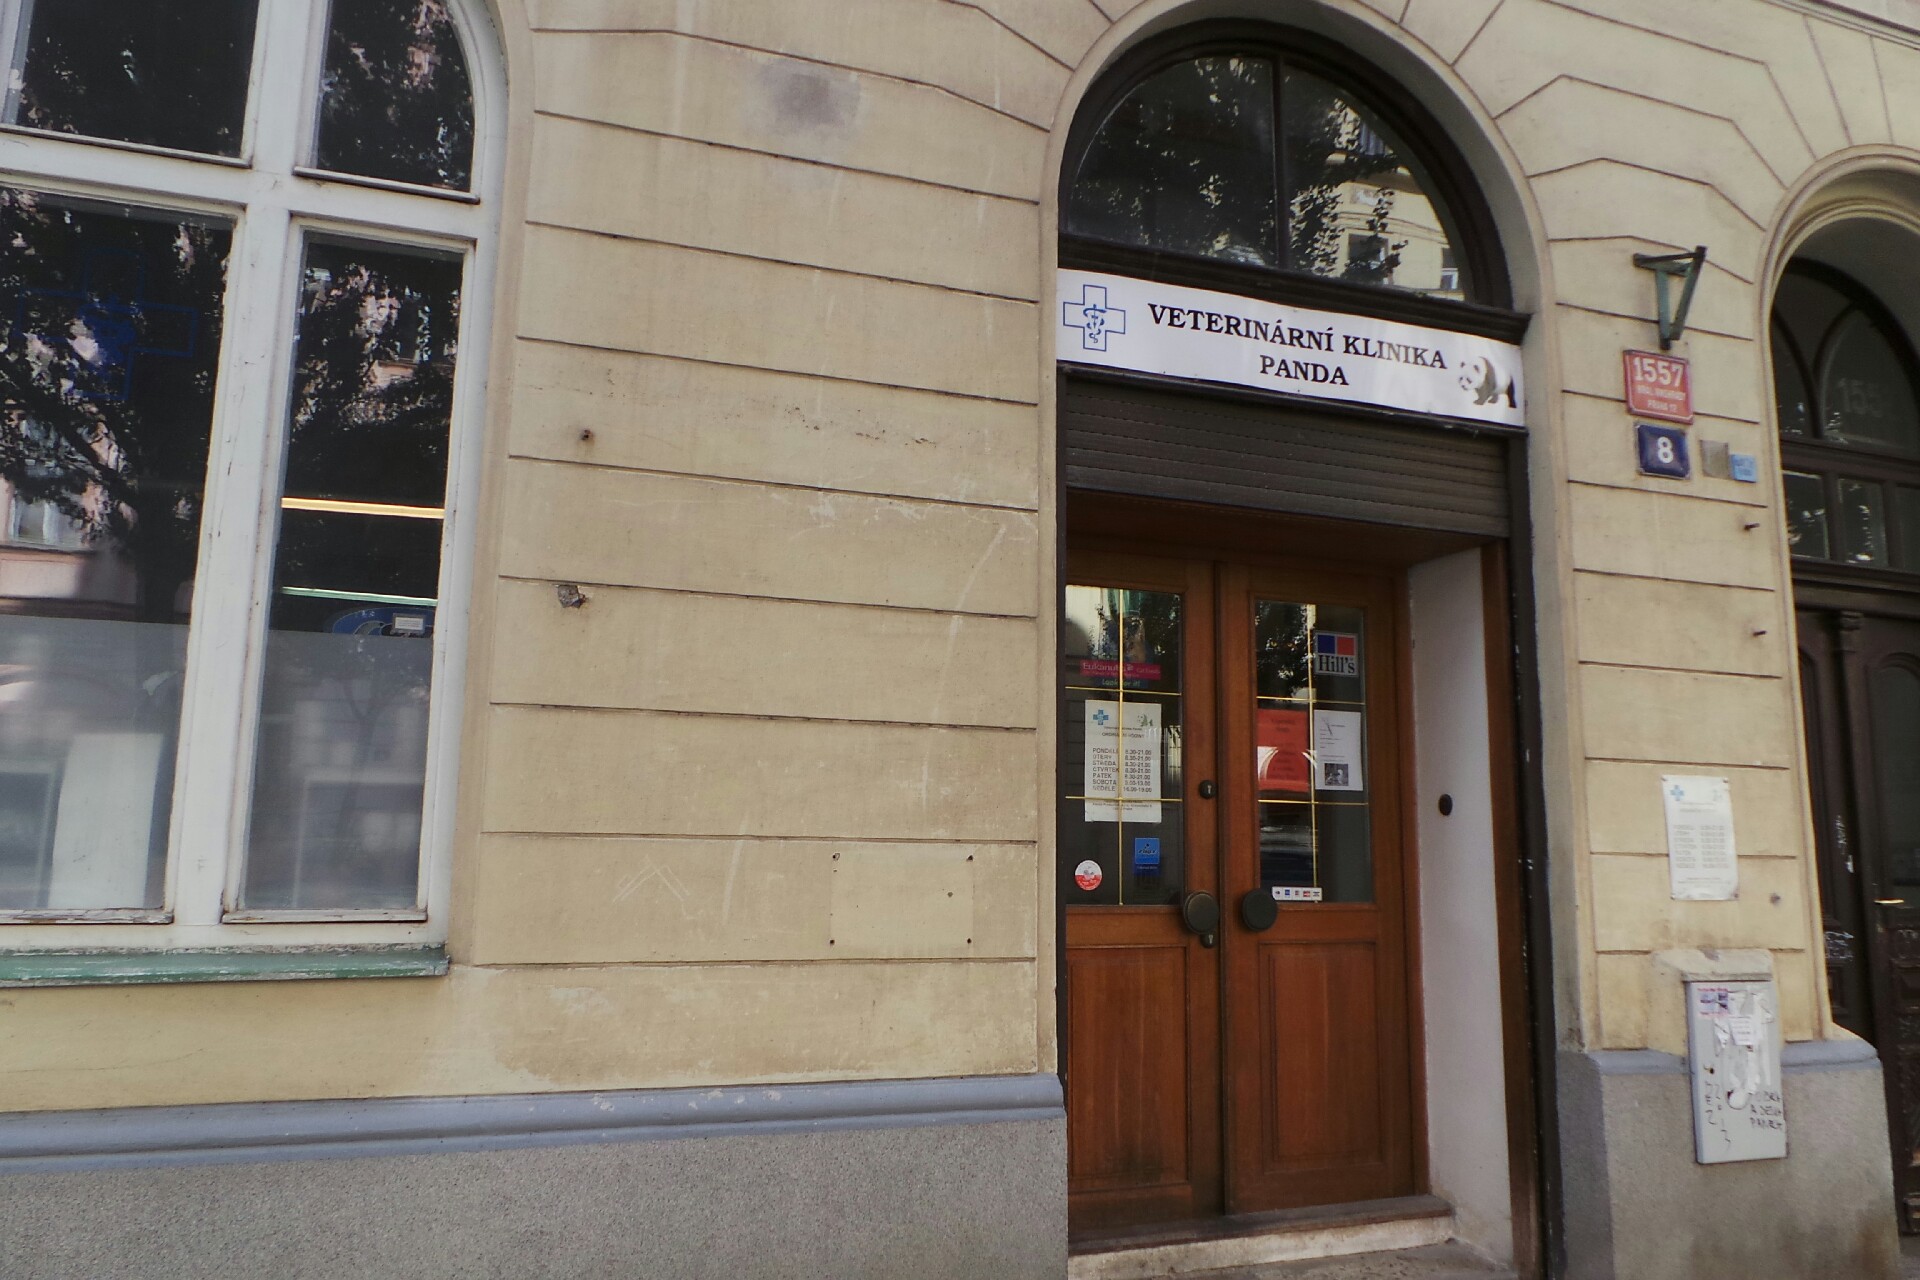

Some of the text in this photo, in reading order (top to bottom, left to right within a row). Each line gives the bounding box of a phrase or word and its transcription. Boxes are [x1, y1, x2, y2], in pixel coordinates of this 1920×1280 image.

[1147, 303, 1448, 370] VETERINÁRNÍ KLINIKA
[1259, 354, 1350, 386] PANDA
[1634, 357, 1684, 387] 1557
[1657, 436, 1674, 463] 8
[1318, 654, 1356, 674] Hill's
